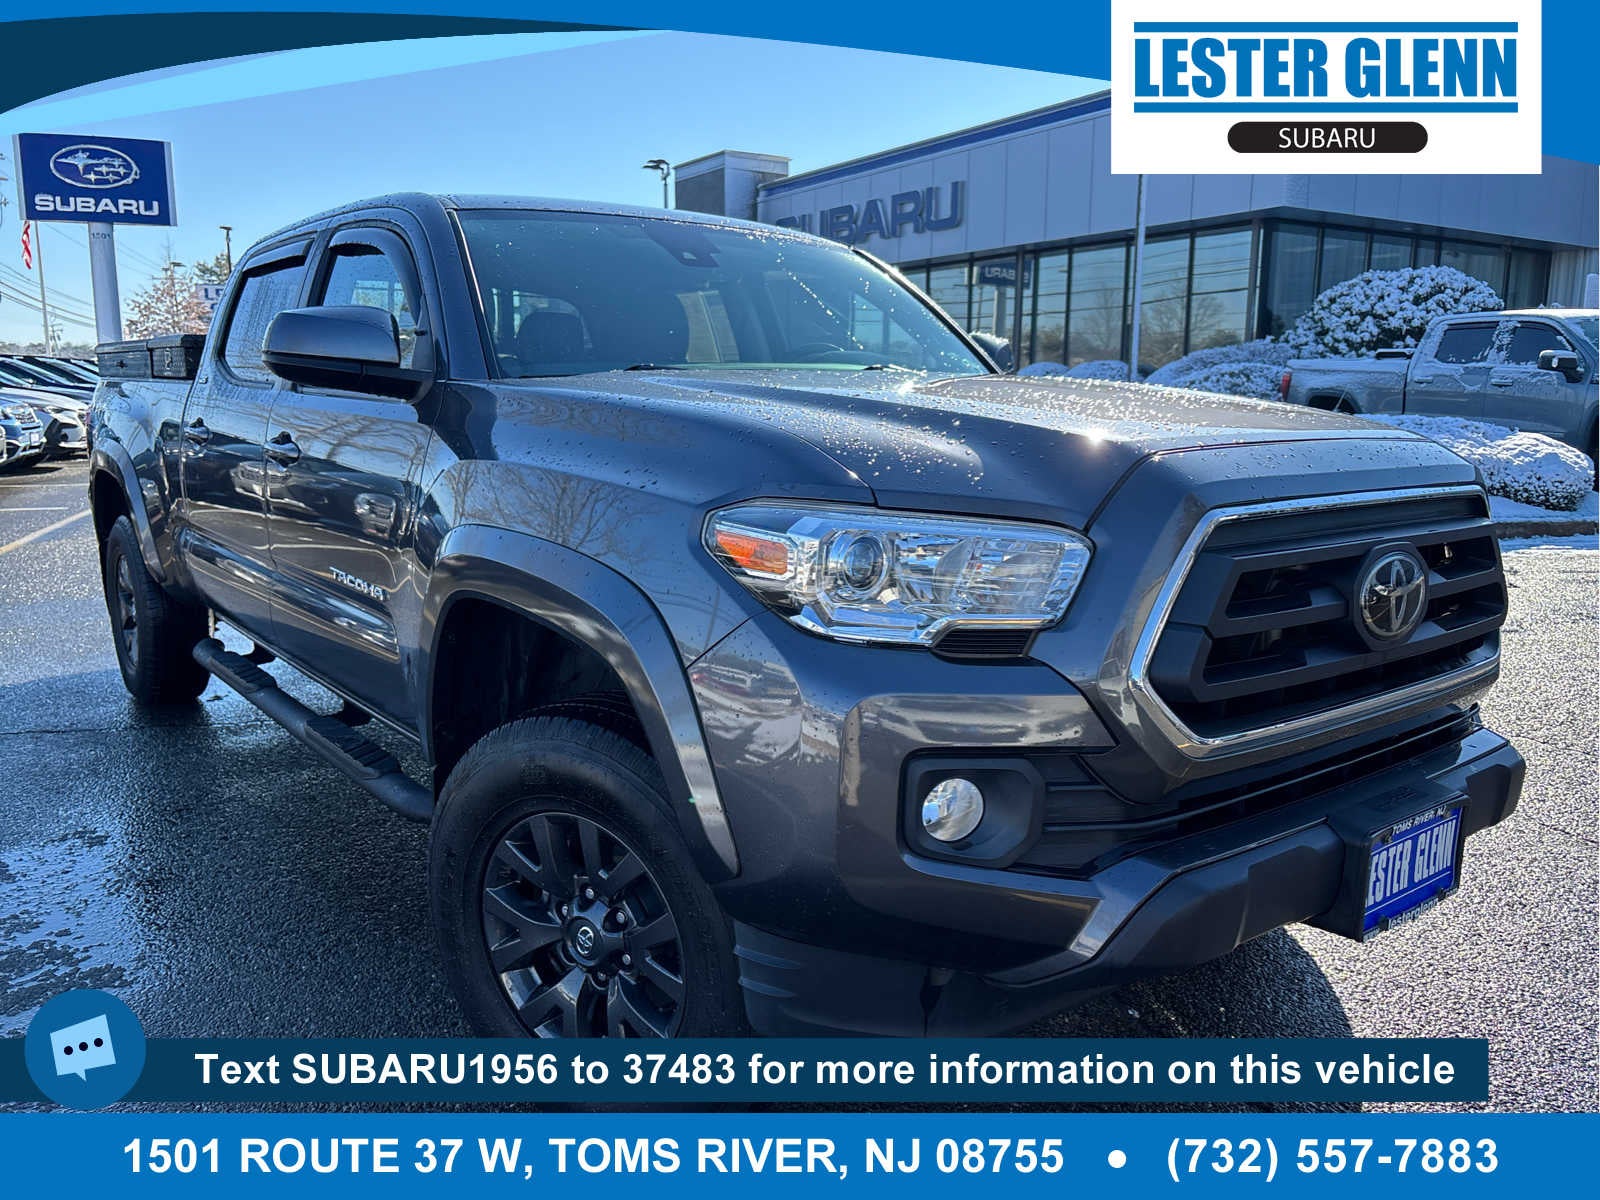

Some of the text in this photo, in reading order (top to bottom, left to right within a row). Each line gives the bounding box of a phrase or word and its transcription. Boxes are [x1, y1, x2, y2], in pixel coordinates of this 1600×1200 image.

[34, 193, 159, 217] SUBARU
[329, 566, 385, 601] TACOMA
[1392, 818, 1413, 835] TOMS
[1365, 820, 1456, 908] ESTER GLENN
